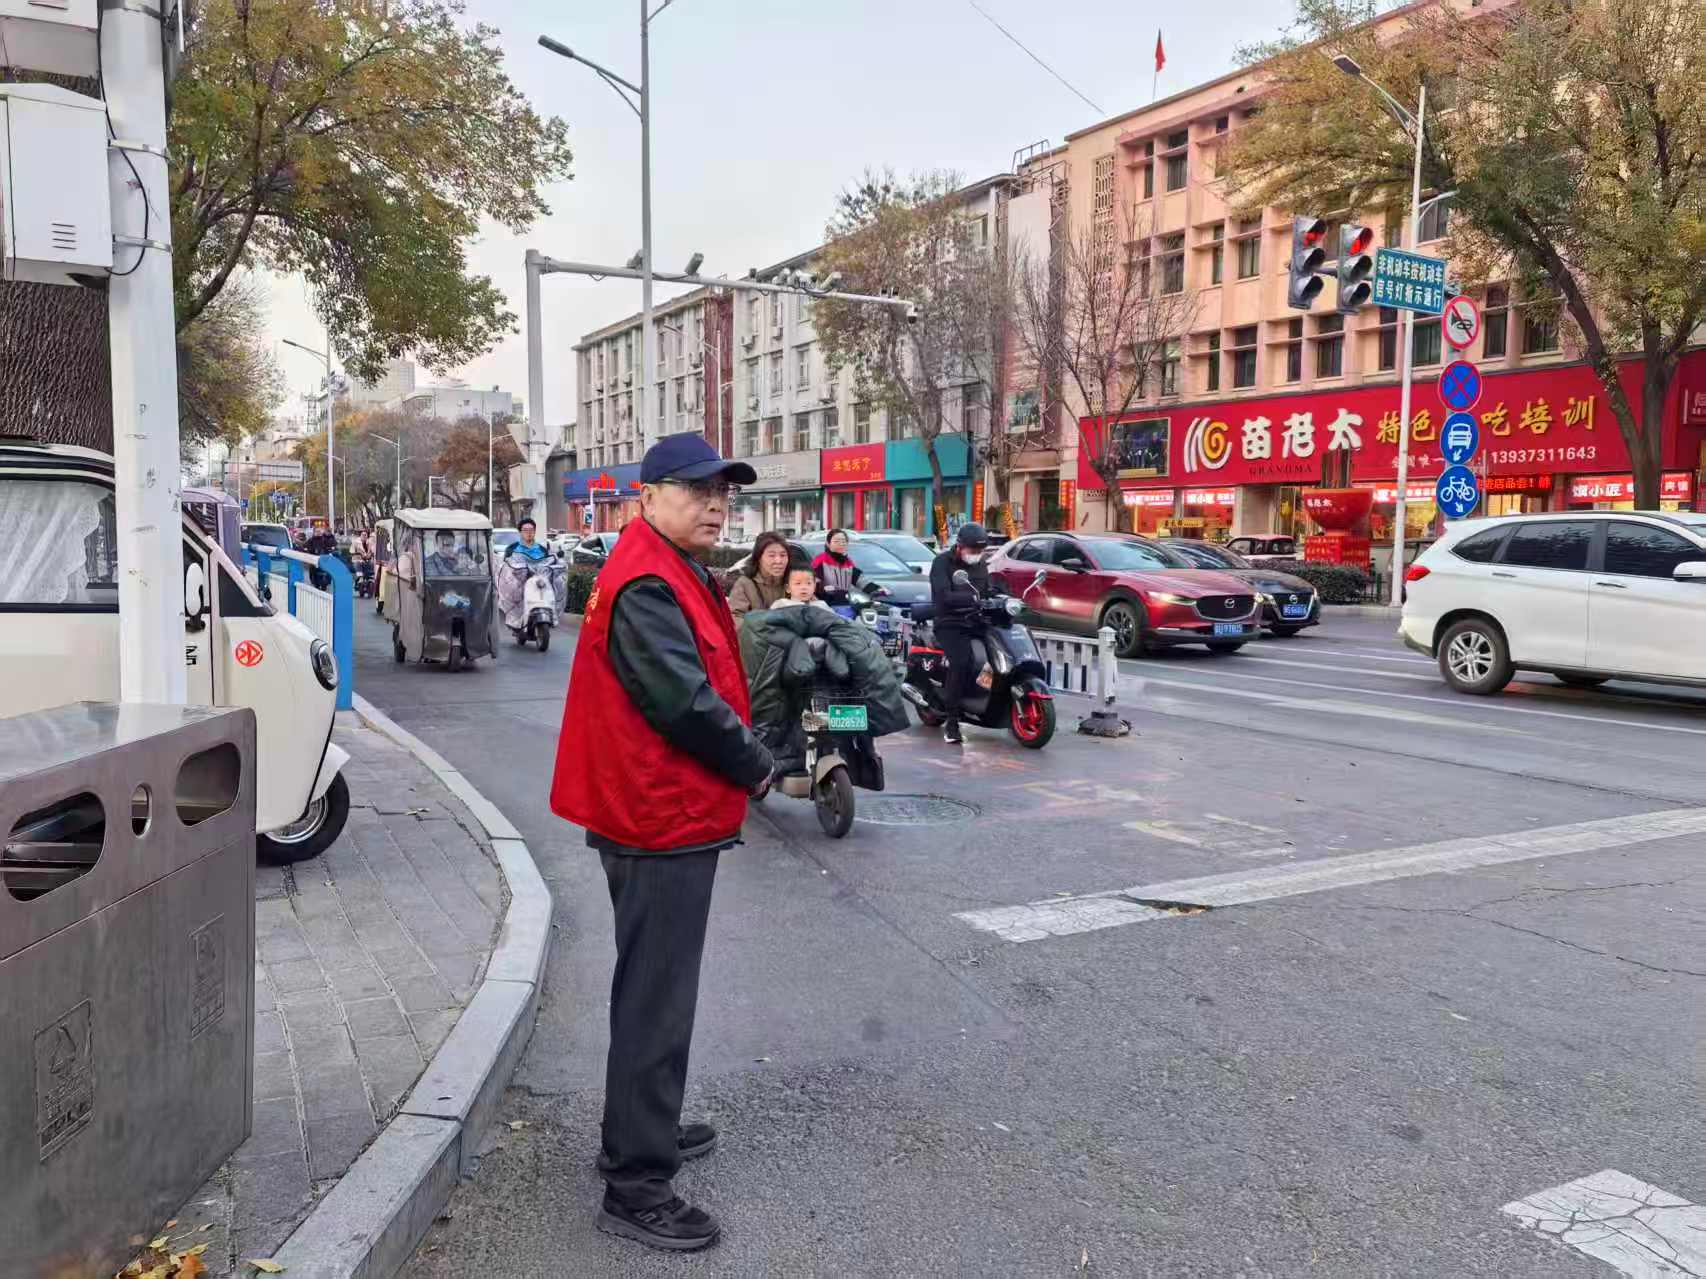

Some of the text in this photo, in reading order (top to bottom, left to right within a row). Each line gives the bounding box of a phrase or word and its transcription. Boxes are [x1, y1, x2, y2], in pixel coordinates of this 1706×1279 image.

[1375, 395, 1595, 443] 特色吃培训
[1491, 446, 1596, 464] 13937311643
